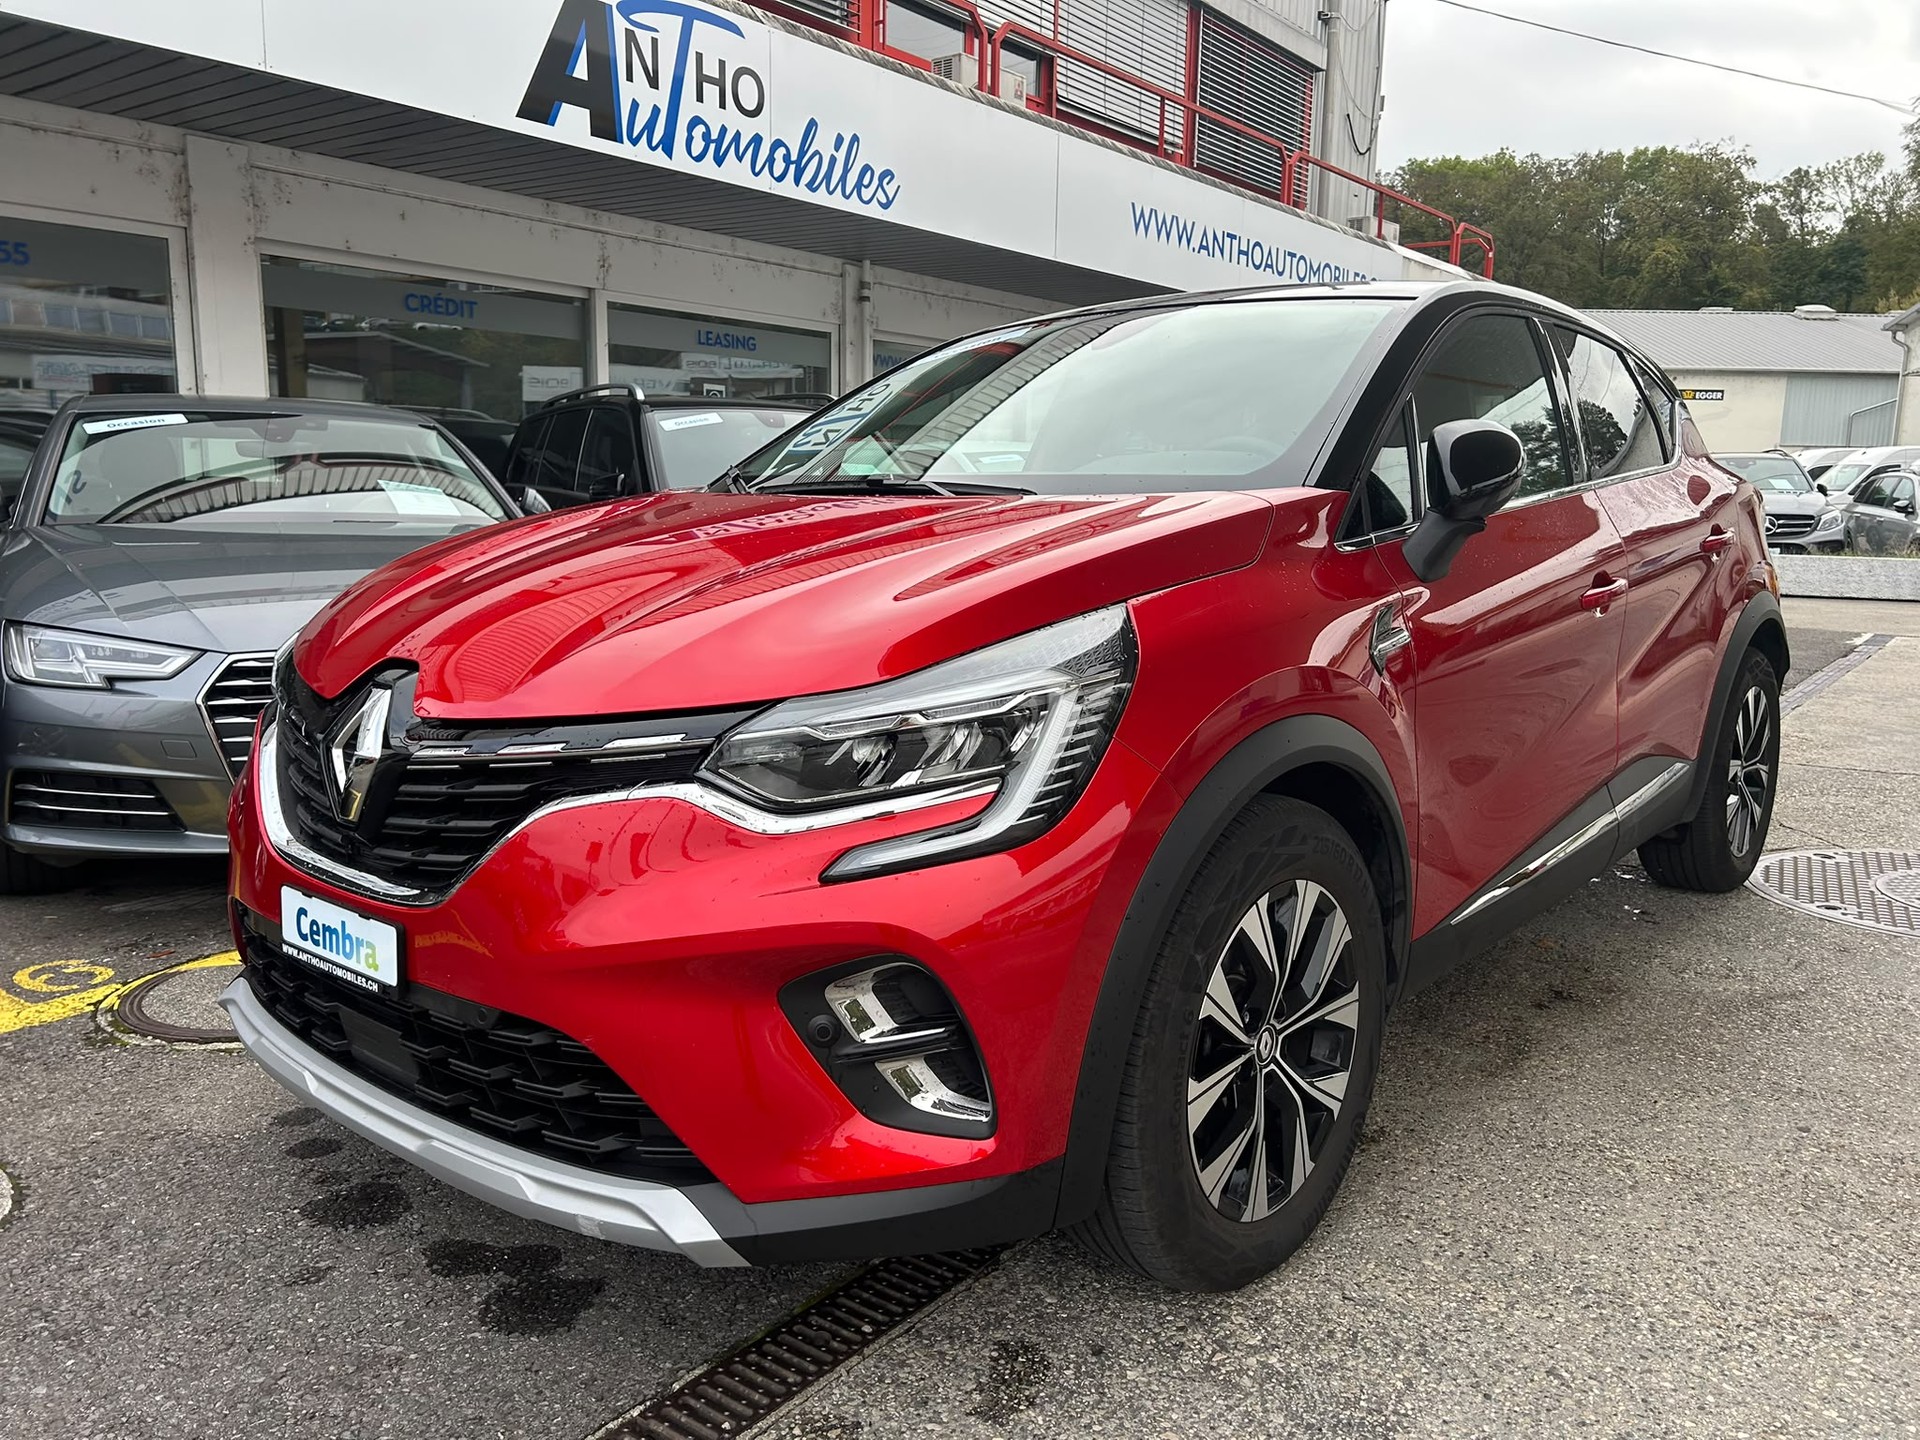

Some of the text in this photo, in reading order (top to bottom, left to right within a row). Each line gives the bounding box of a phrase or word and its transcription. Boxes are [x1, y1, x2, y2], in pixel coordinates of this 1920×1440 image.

[515, 0, 765, 160] ANTHO
[1131, 202, 1377, 283] WWW.ANTHOAUTOMOBIL
[405, 292, 478, 318] CRÉDIT
[698, 330, 757, 351] LEASING
[1695, 391, 1723, 400] EGGER
[107, 418, 166, 428] Occasion
[296, 906, 379, 973] Cembra
[282, 943, 379, 993] WWW.ANTHOAUTOMOBILES.CH
